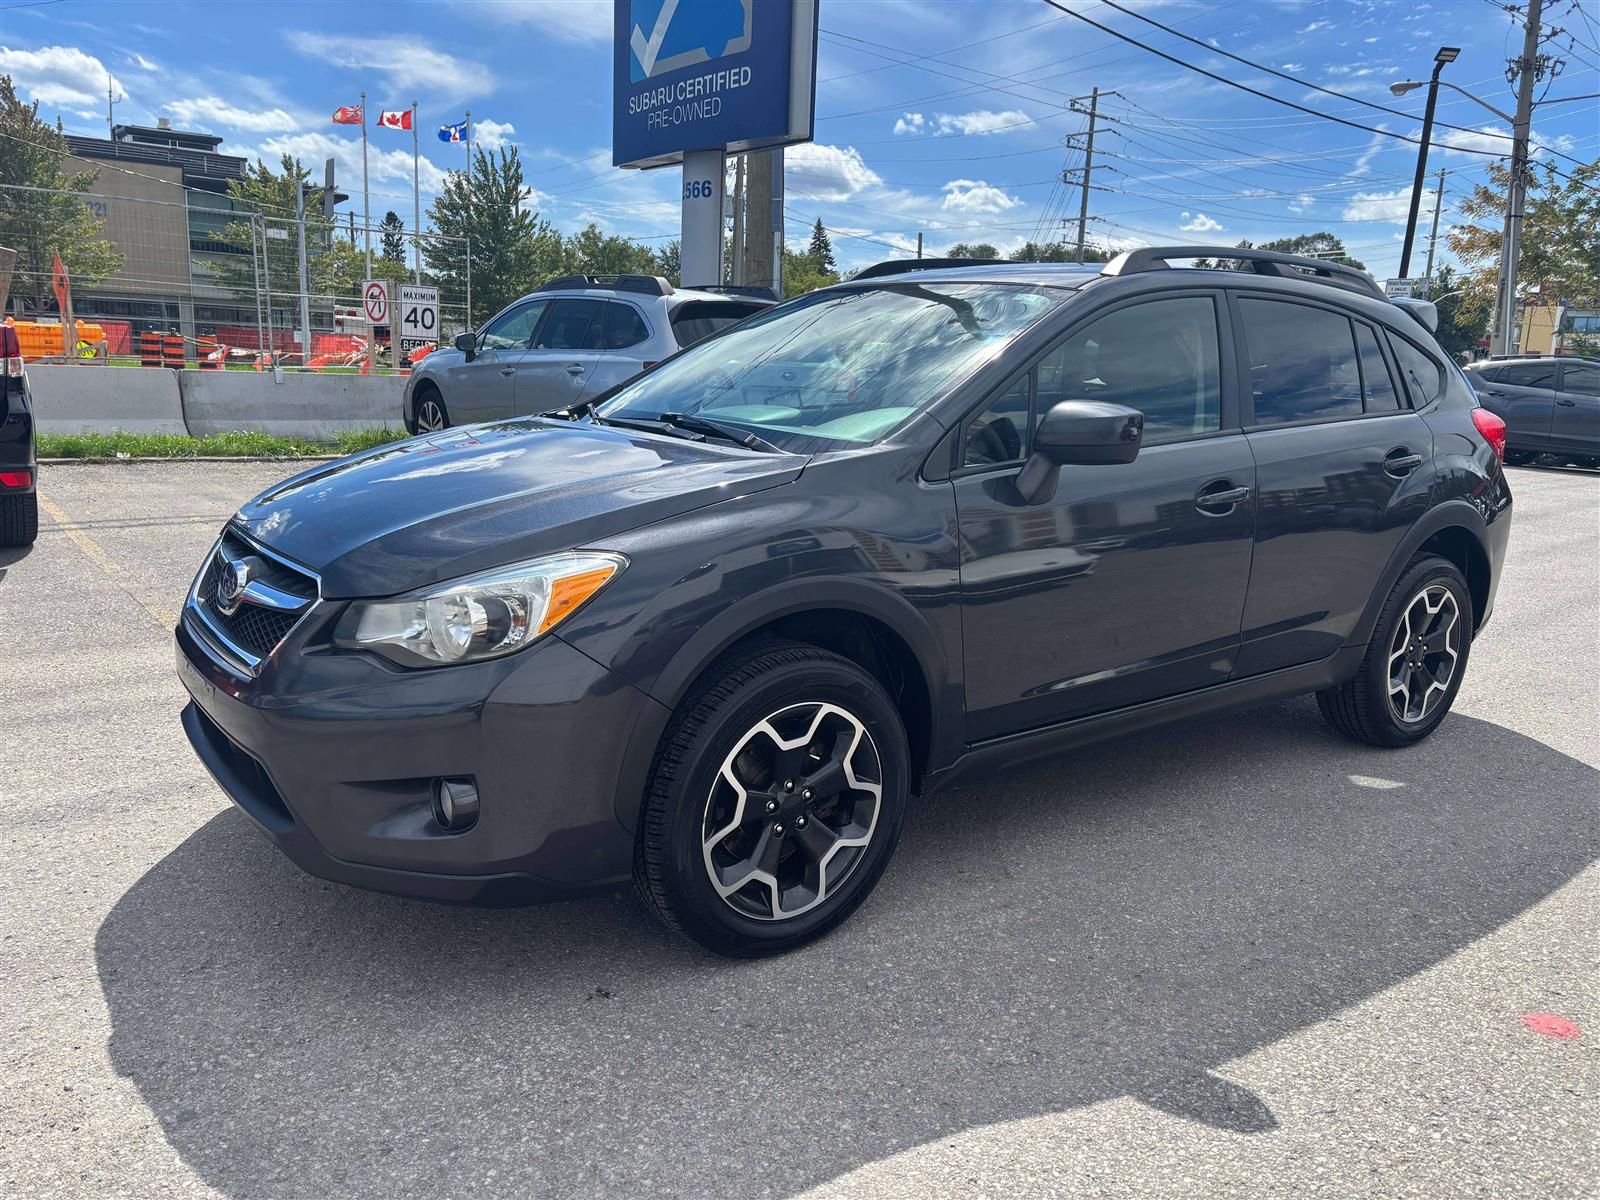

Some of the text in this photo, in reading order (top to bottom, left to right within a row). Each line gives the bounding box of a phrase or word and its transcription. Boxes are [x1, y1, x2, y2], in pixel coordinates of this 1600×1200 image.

[629, 65, 752, 114] SUBARU CERTIFIED
[647, 96, 722, 130] PRE-OWNED
[683, 180, 713, 200] 566
[403, 291, 436, 301] MAXIMUM
[404, 306, 436, 330] 40
